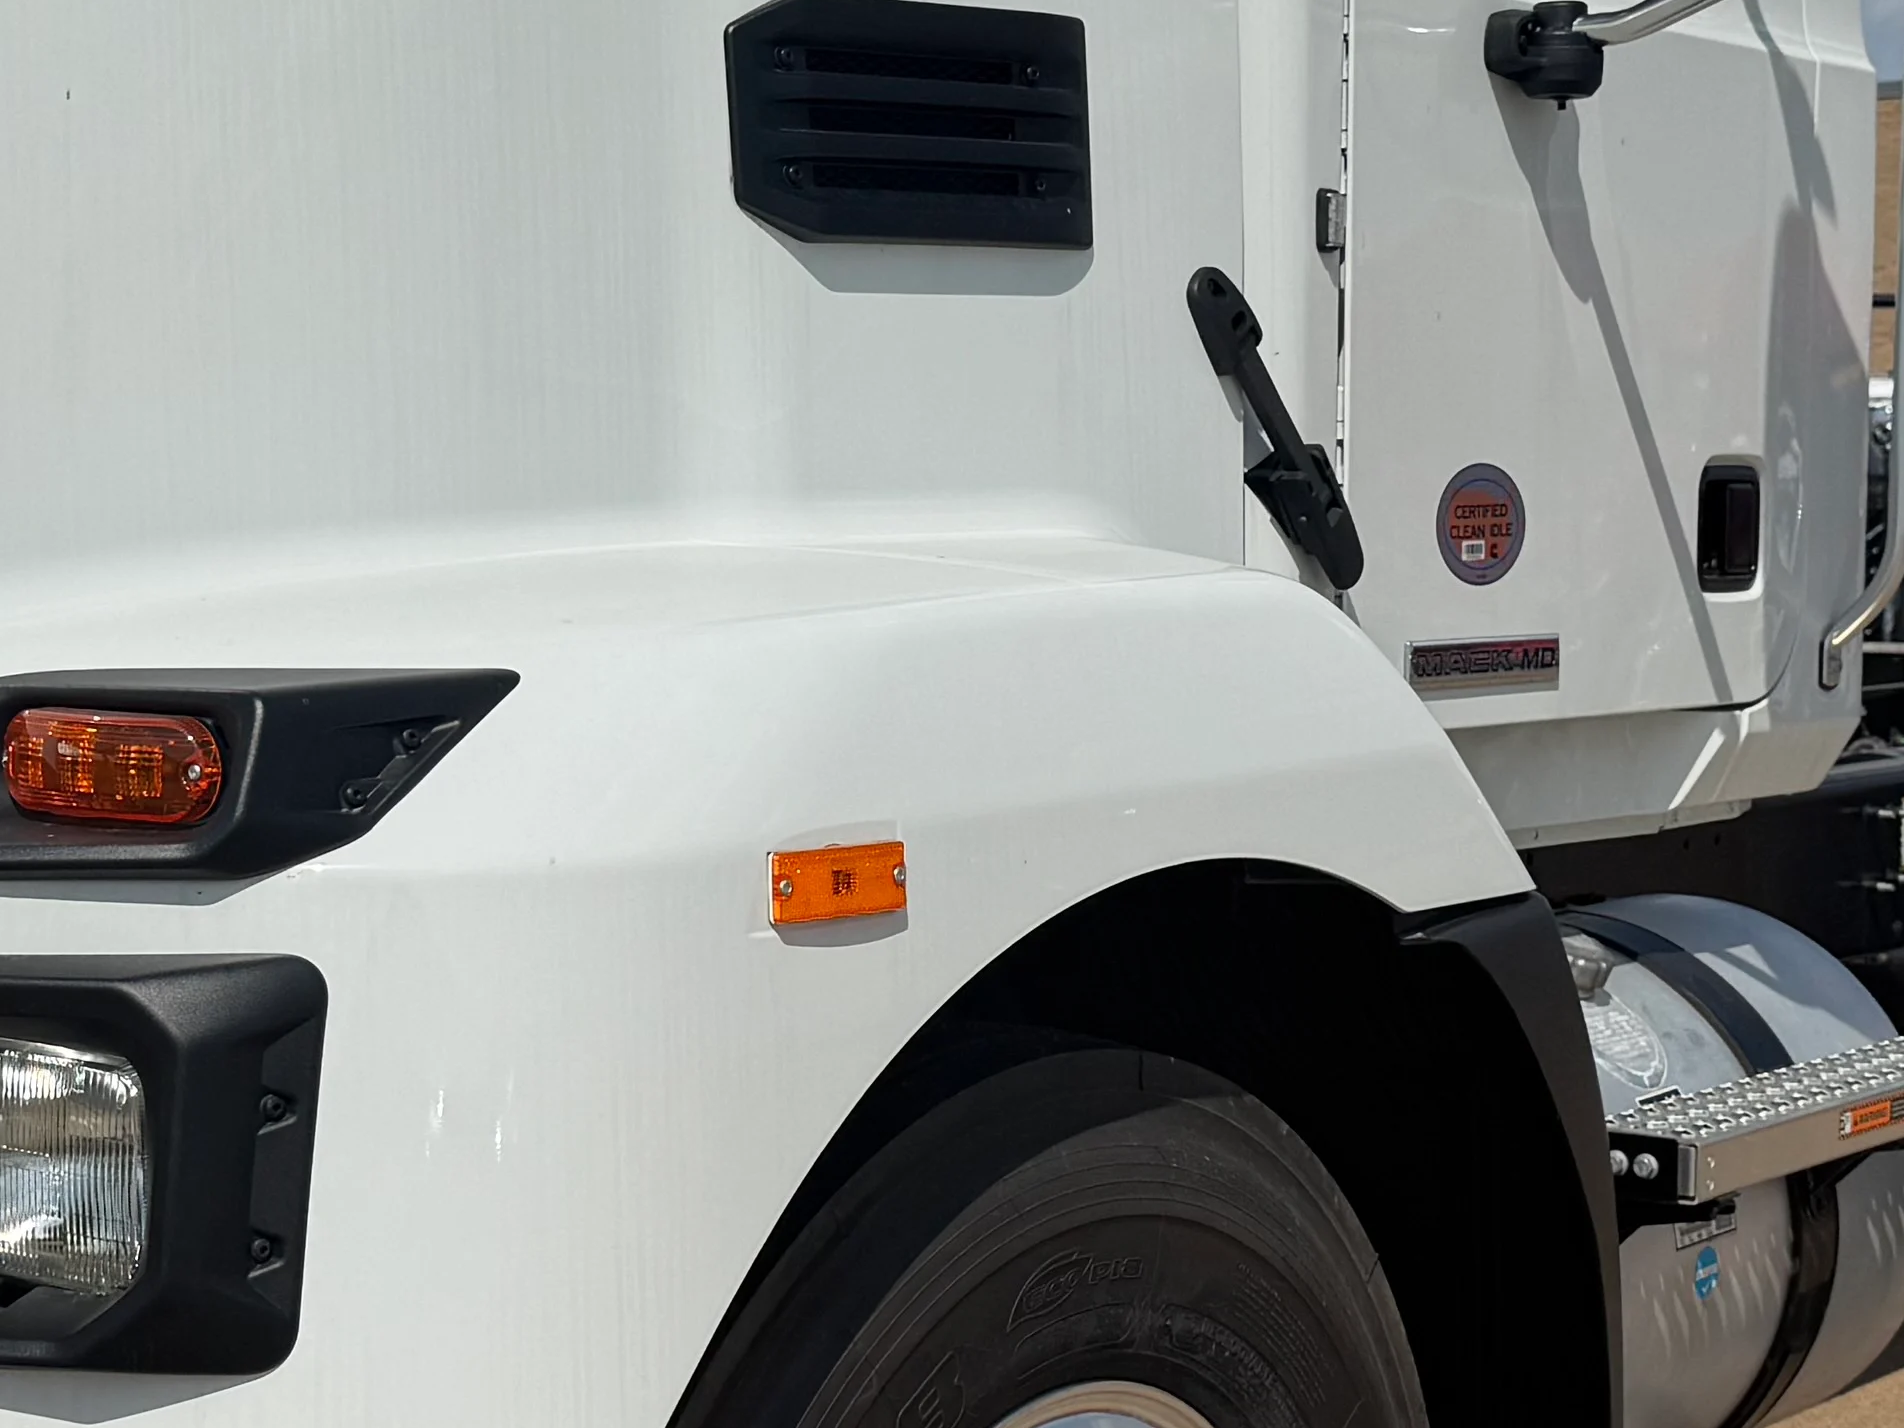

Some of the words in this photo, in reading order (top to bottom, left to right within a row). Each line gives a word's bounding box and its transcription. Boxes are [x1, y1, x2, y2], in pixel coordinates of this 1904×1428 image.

[1454, 503, 1509, 520] CERTIFIED
[1449, 524, 1486, 540] CLEAN
[1489, 522, 1514, 538] IDLE
[1416, 649, 1513, 677] MACK
